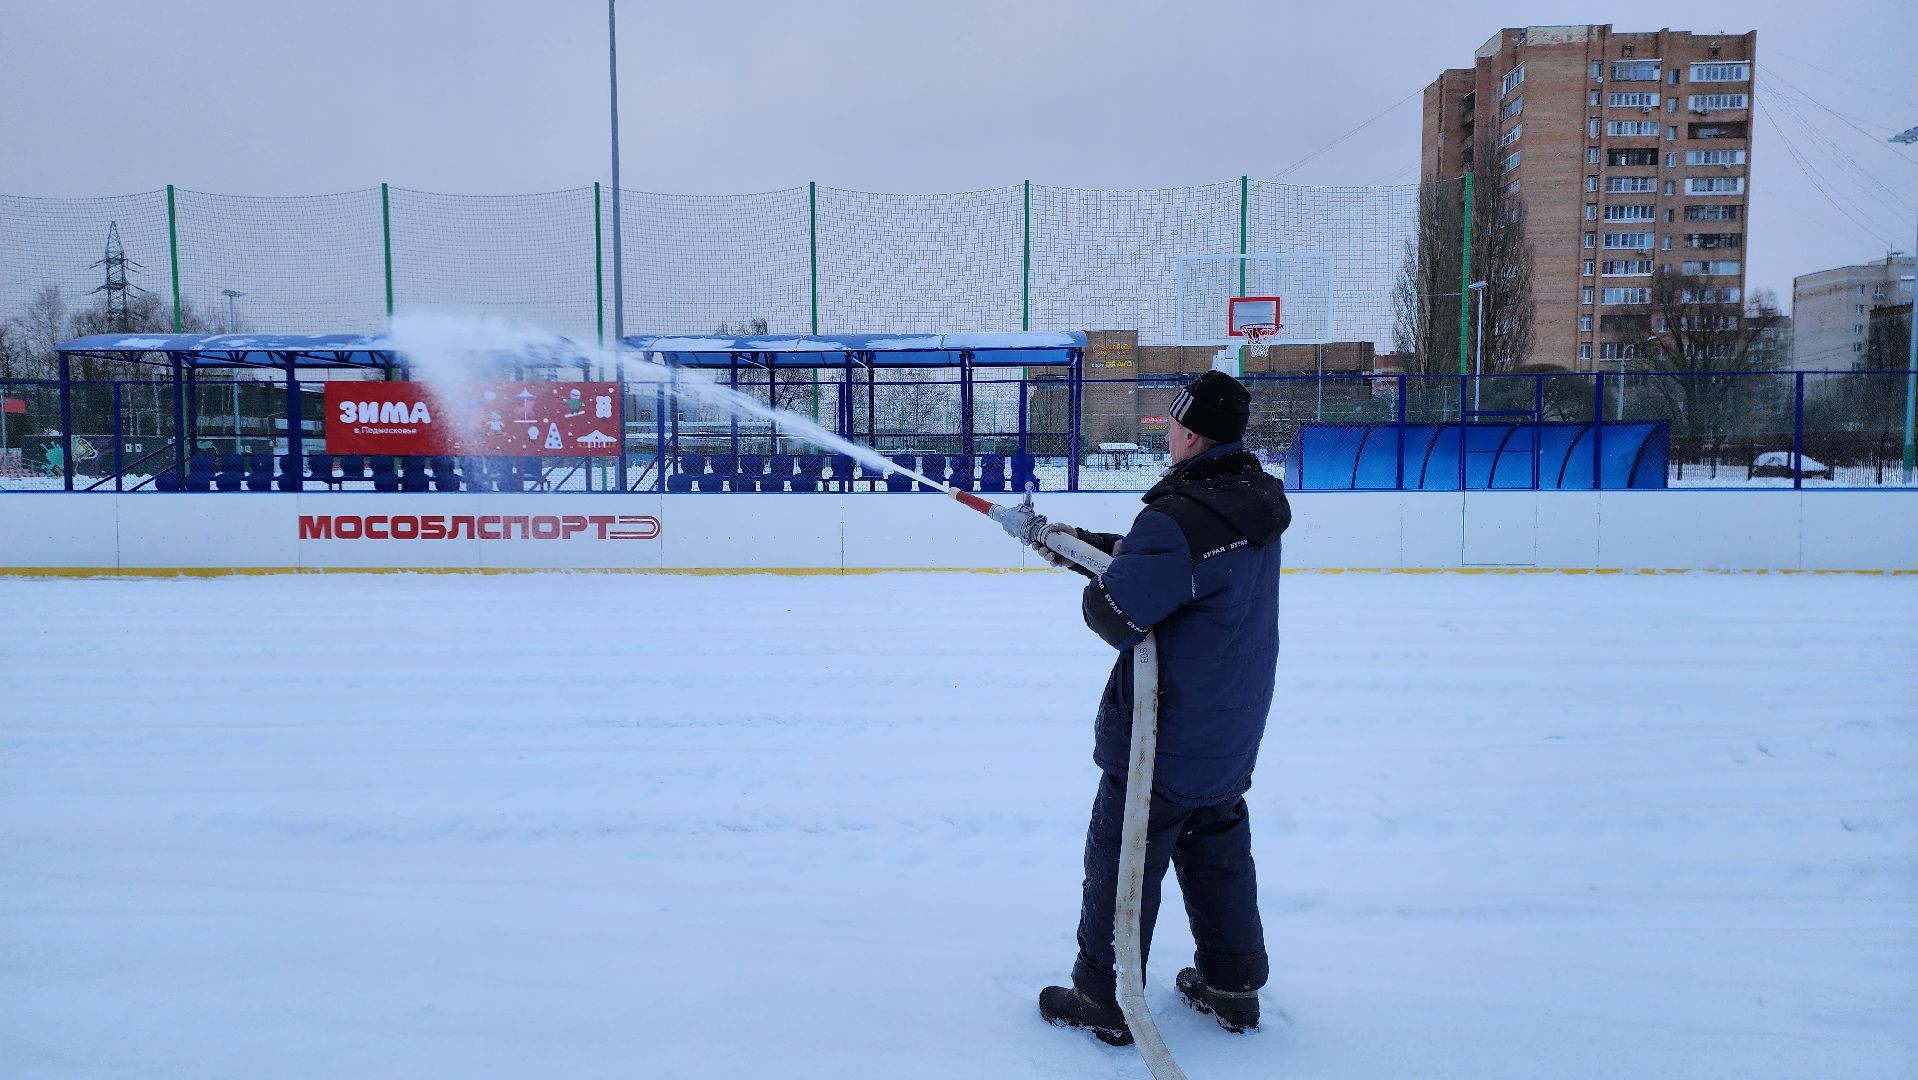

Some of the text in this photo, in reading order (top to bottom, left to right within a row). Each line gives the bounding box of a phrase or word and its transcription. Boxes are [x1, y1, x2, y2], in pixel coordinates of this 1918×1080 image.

[339, 401, 431, 423] ЗИМА
[361, 426, 418, 435] Подмосковье
[299, 515, 616, 540] МОСОБЛСПОРТ
